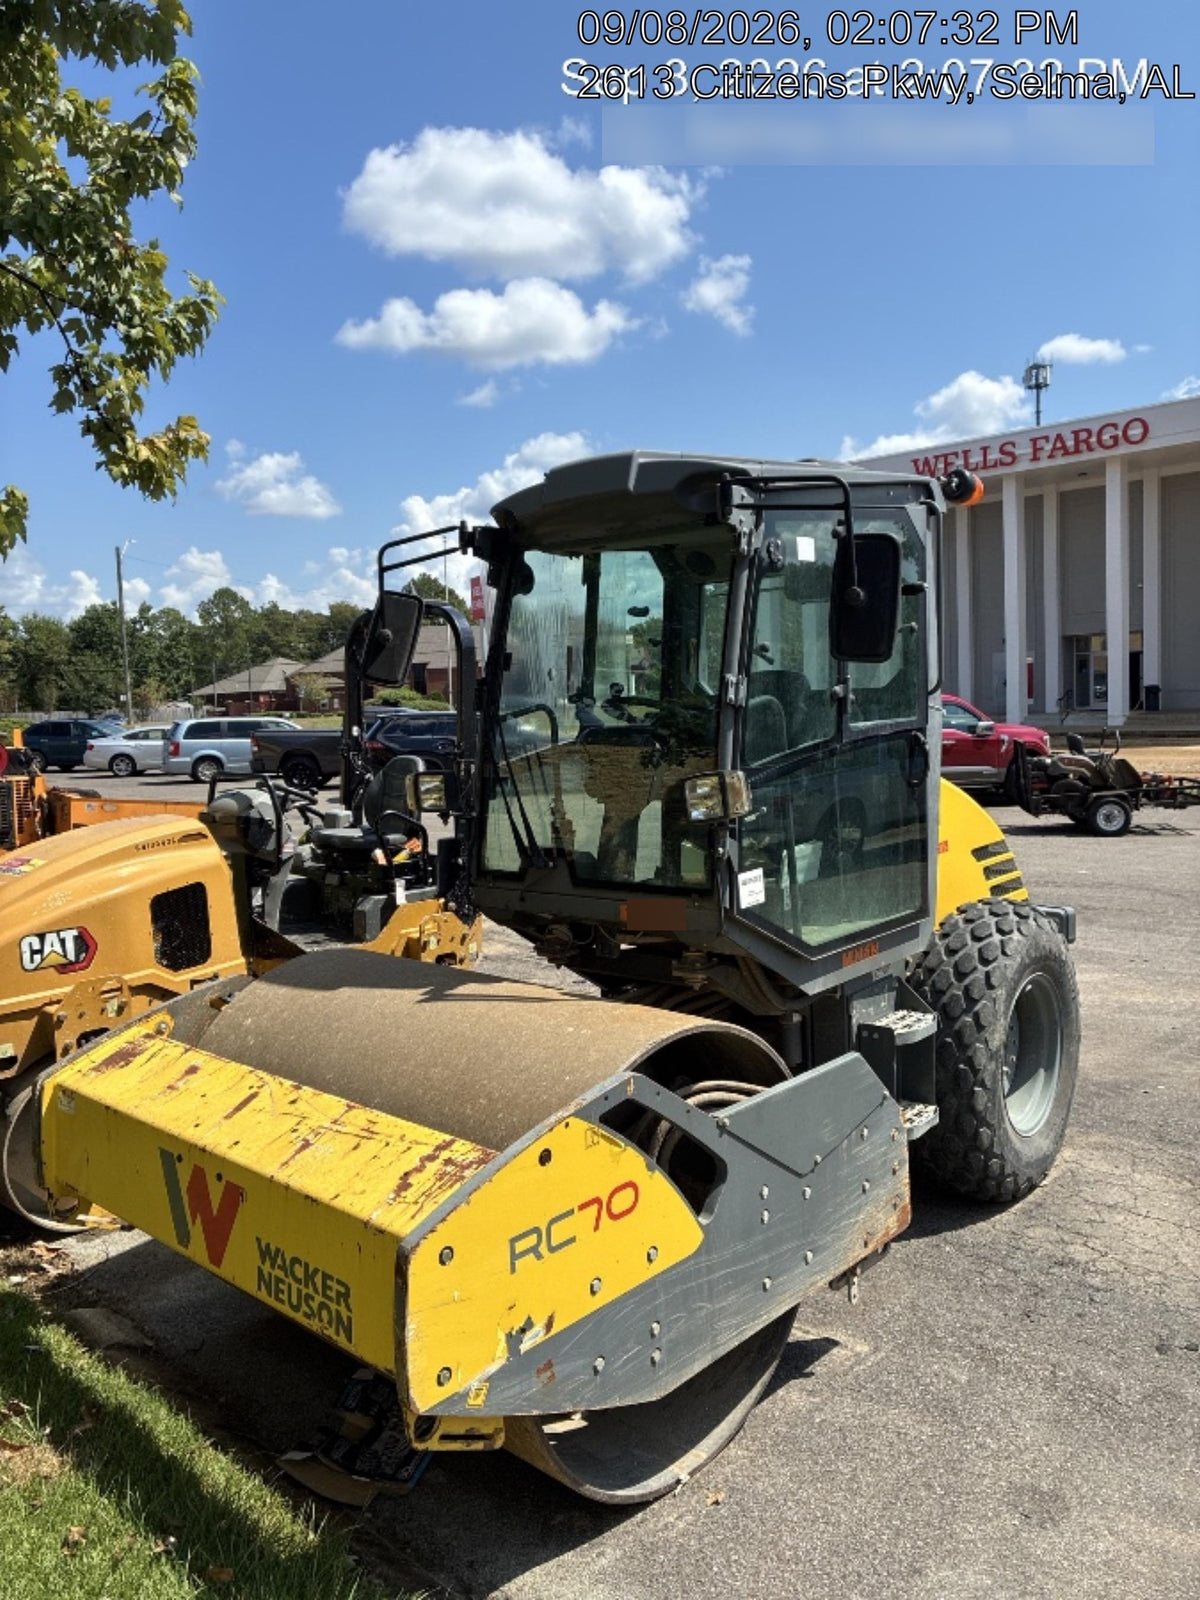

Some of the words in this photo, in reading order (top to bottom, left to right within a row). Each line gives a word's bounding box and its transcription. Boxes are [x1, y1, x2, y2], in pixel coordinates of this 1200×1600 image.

[910, 441, 1018, 478] WELLS
[1029, 417, 1150, 462] FARGO
[21, 927, 80, 971] CAT
[509, 1180, 640, 1275] RC70
[255, 1236, 353, 1314] WACKER
[256, 1264, 353, 1345] NEUSON
